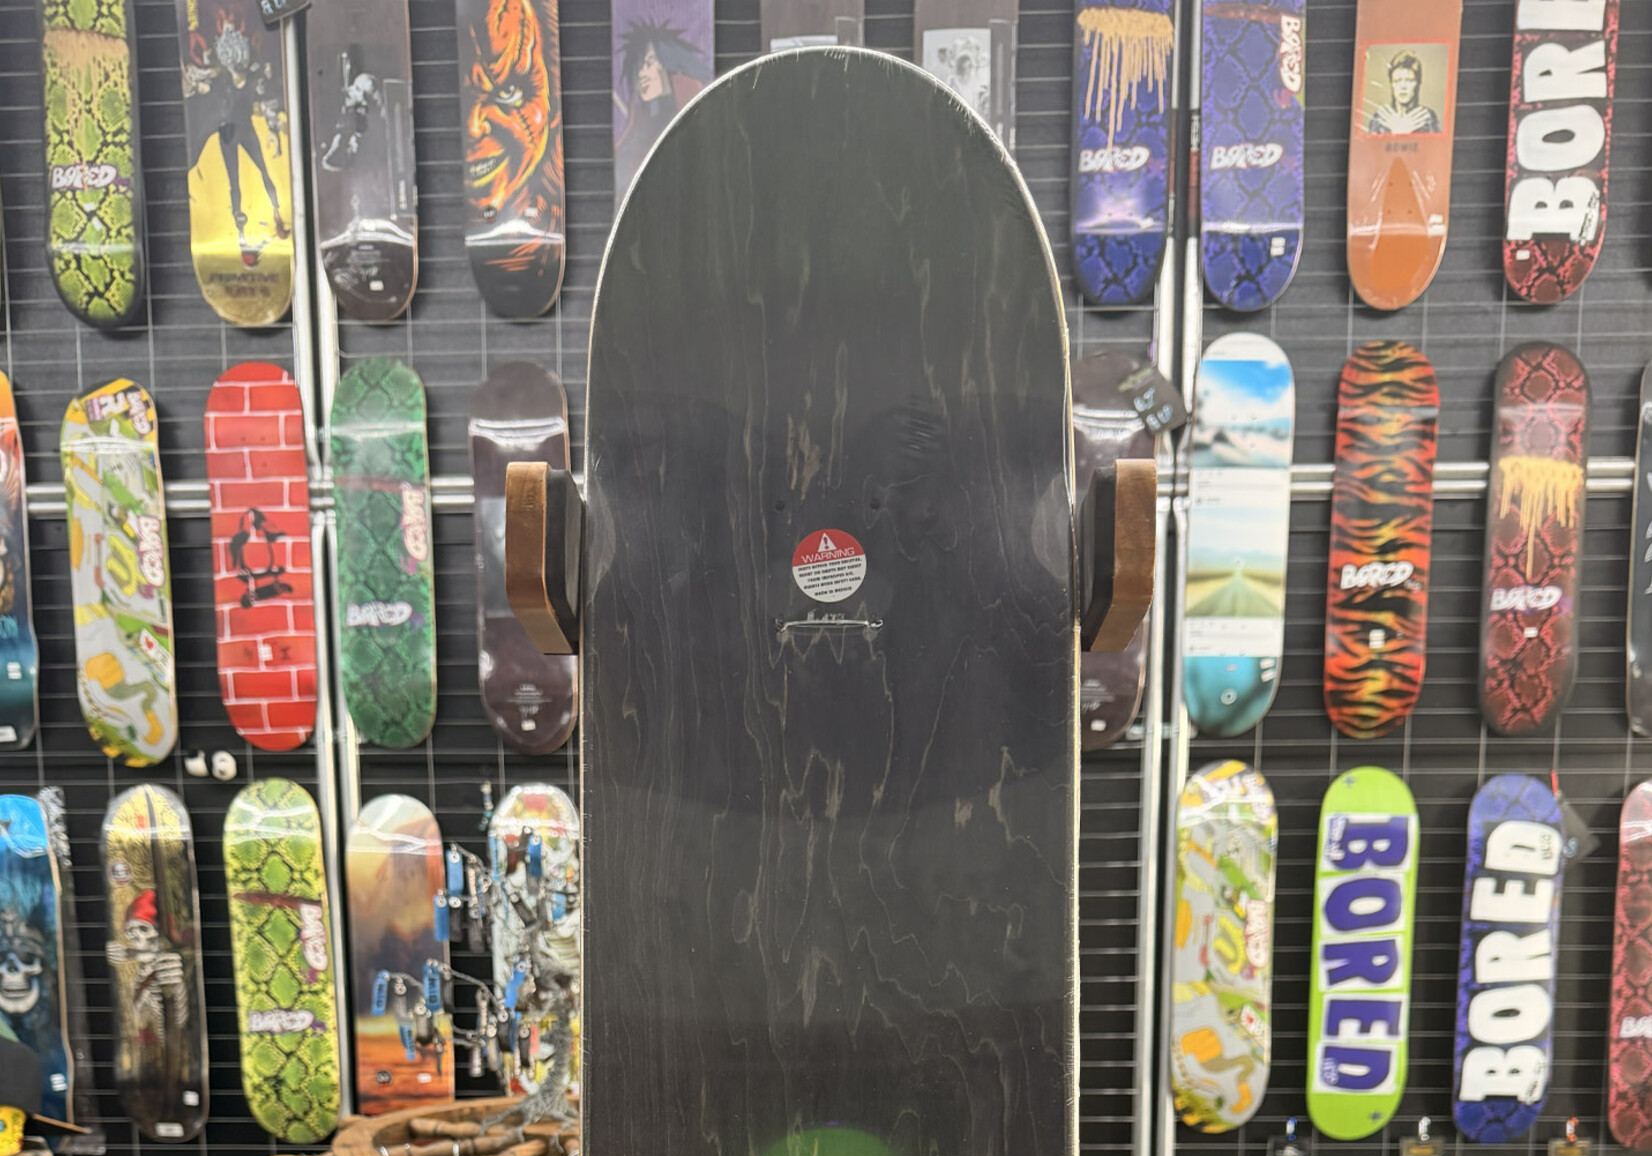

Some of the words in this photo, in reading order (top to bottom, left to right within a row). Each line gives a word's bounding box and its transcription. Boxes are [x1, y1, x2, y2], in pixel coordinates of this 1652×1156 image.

[801, 547, 855, 564] WARNING
[1322, 815, 1409, 1090] BORED
[1459, 820, 1565, 1102] BORED
